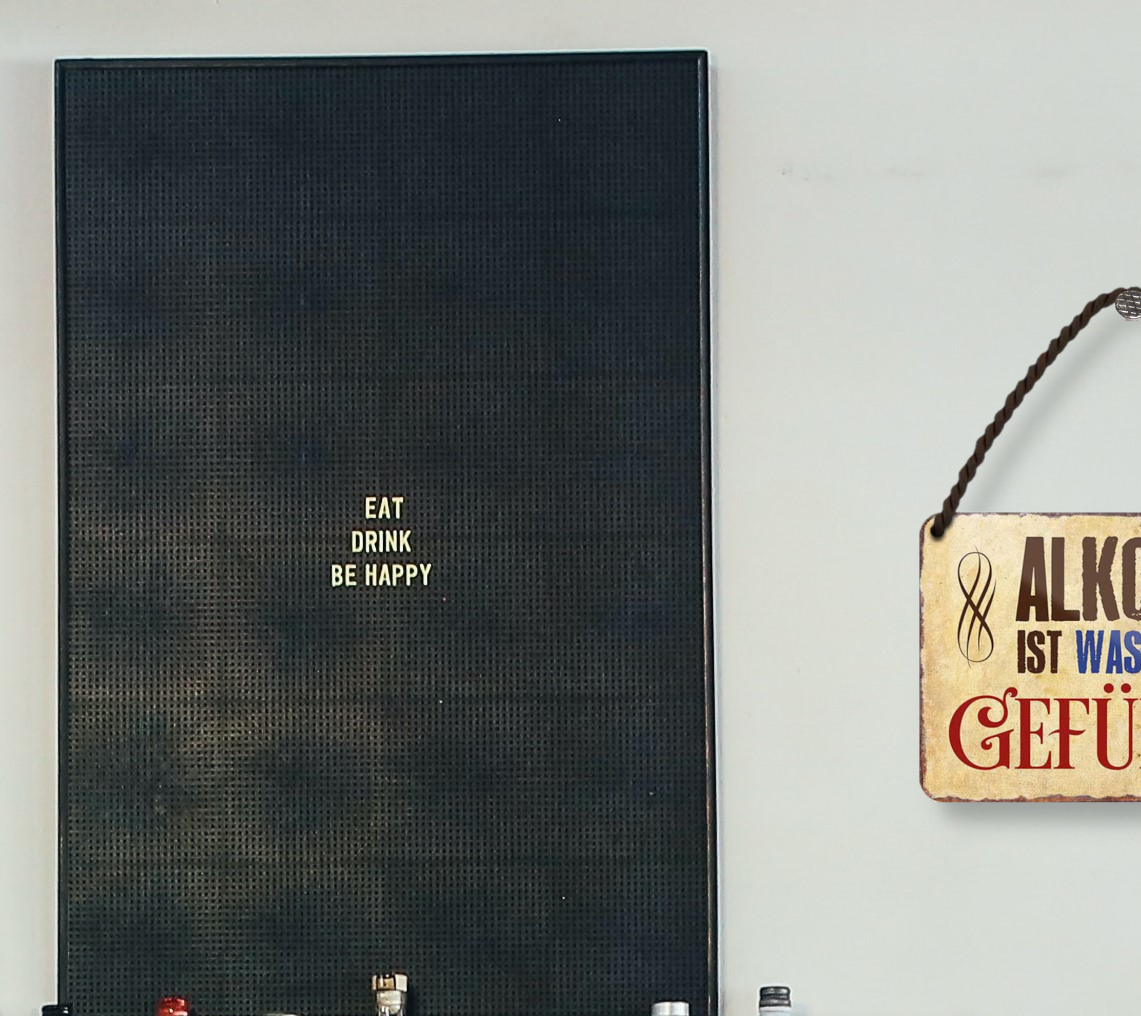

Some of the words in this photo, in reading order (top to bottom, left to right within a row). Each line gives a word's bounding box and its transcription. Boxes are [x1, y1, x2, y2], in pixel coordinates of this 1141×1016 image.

[365, 496, 404, 519] EAT
[351, 529, 411, 553] DRINK
[331, 564, 357, 587] BE
[365, 563, 432, 587] HAPPY
[1016, 629, 1062, 674] IST
